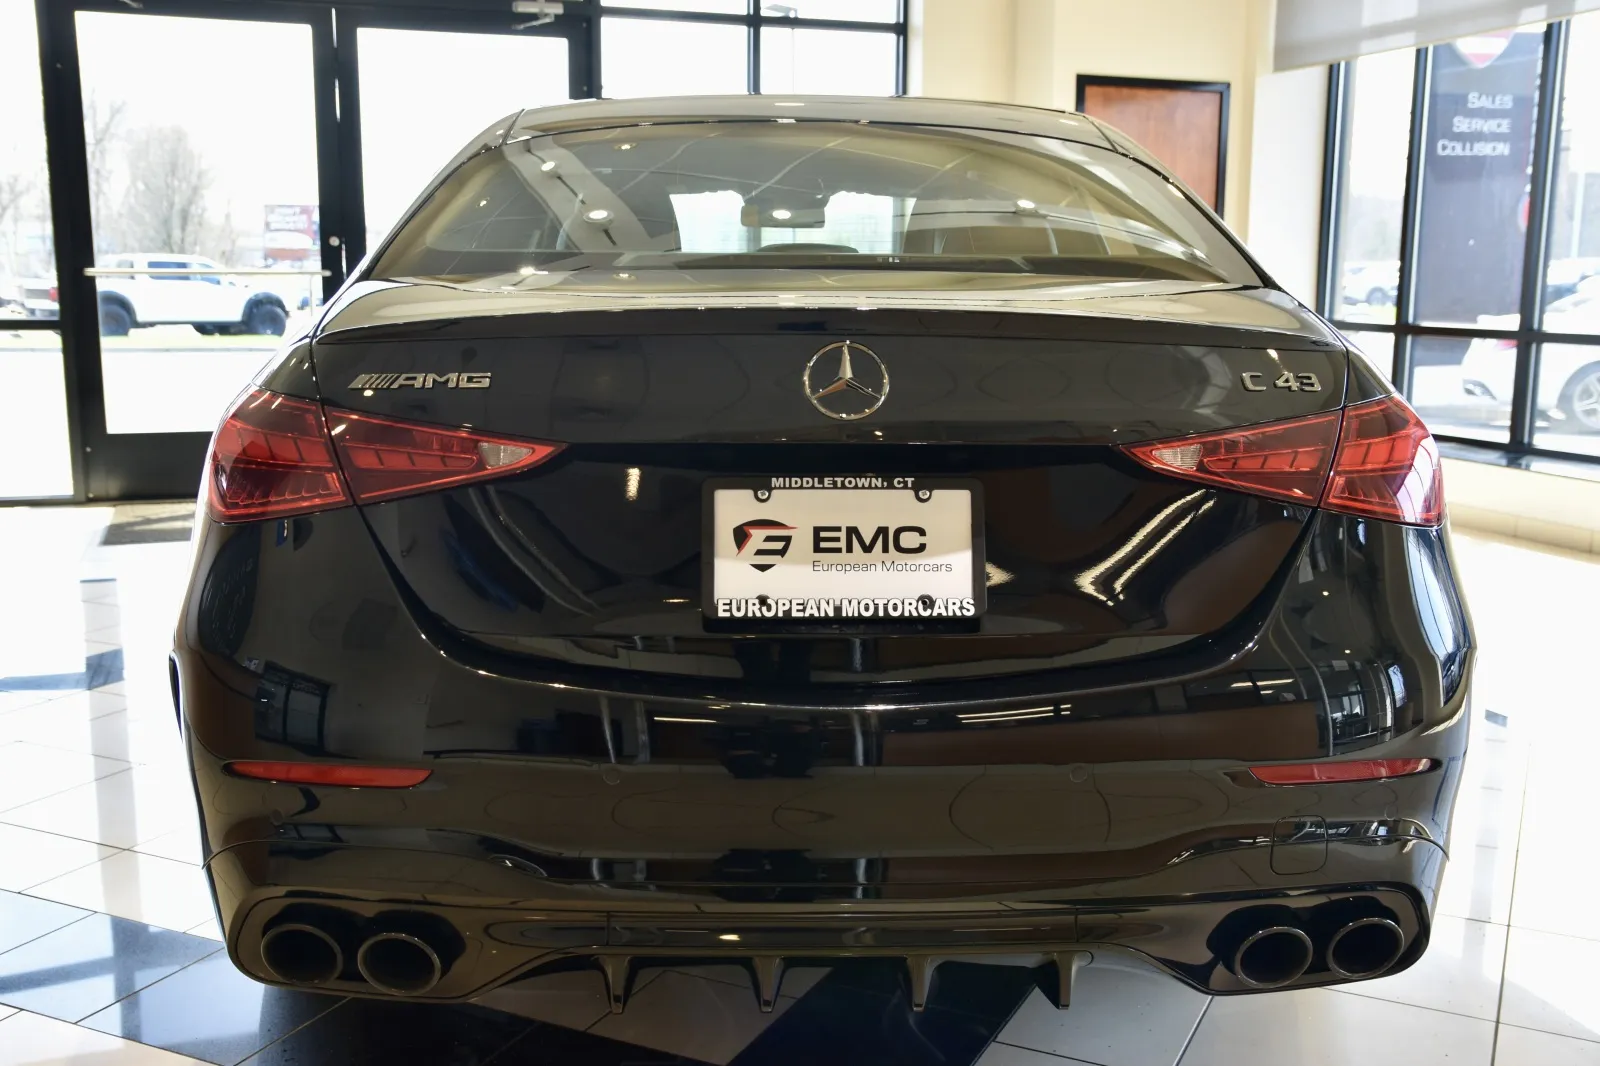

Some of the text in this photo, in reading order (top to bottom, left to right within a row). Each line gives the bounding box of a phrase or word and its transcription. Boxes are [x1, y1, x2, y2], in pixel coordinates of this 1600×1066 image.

[1241, 371, 1321, 392] C 43
[771, 477, 915, 488] MIDDLETOWN, CT
[812, 525, 927, 554] EMC
[812, 560, 953, 574] European Motorcars
[717, 598, 975, 617] EUROPEAN MOTORCARS
